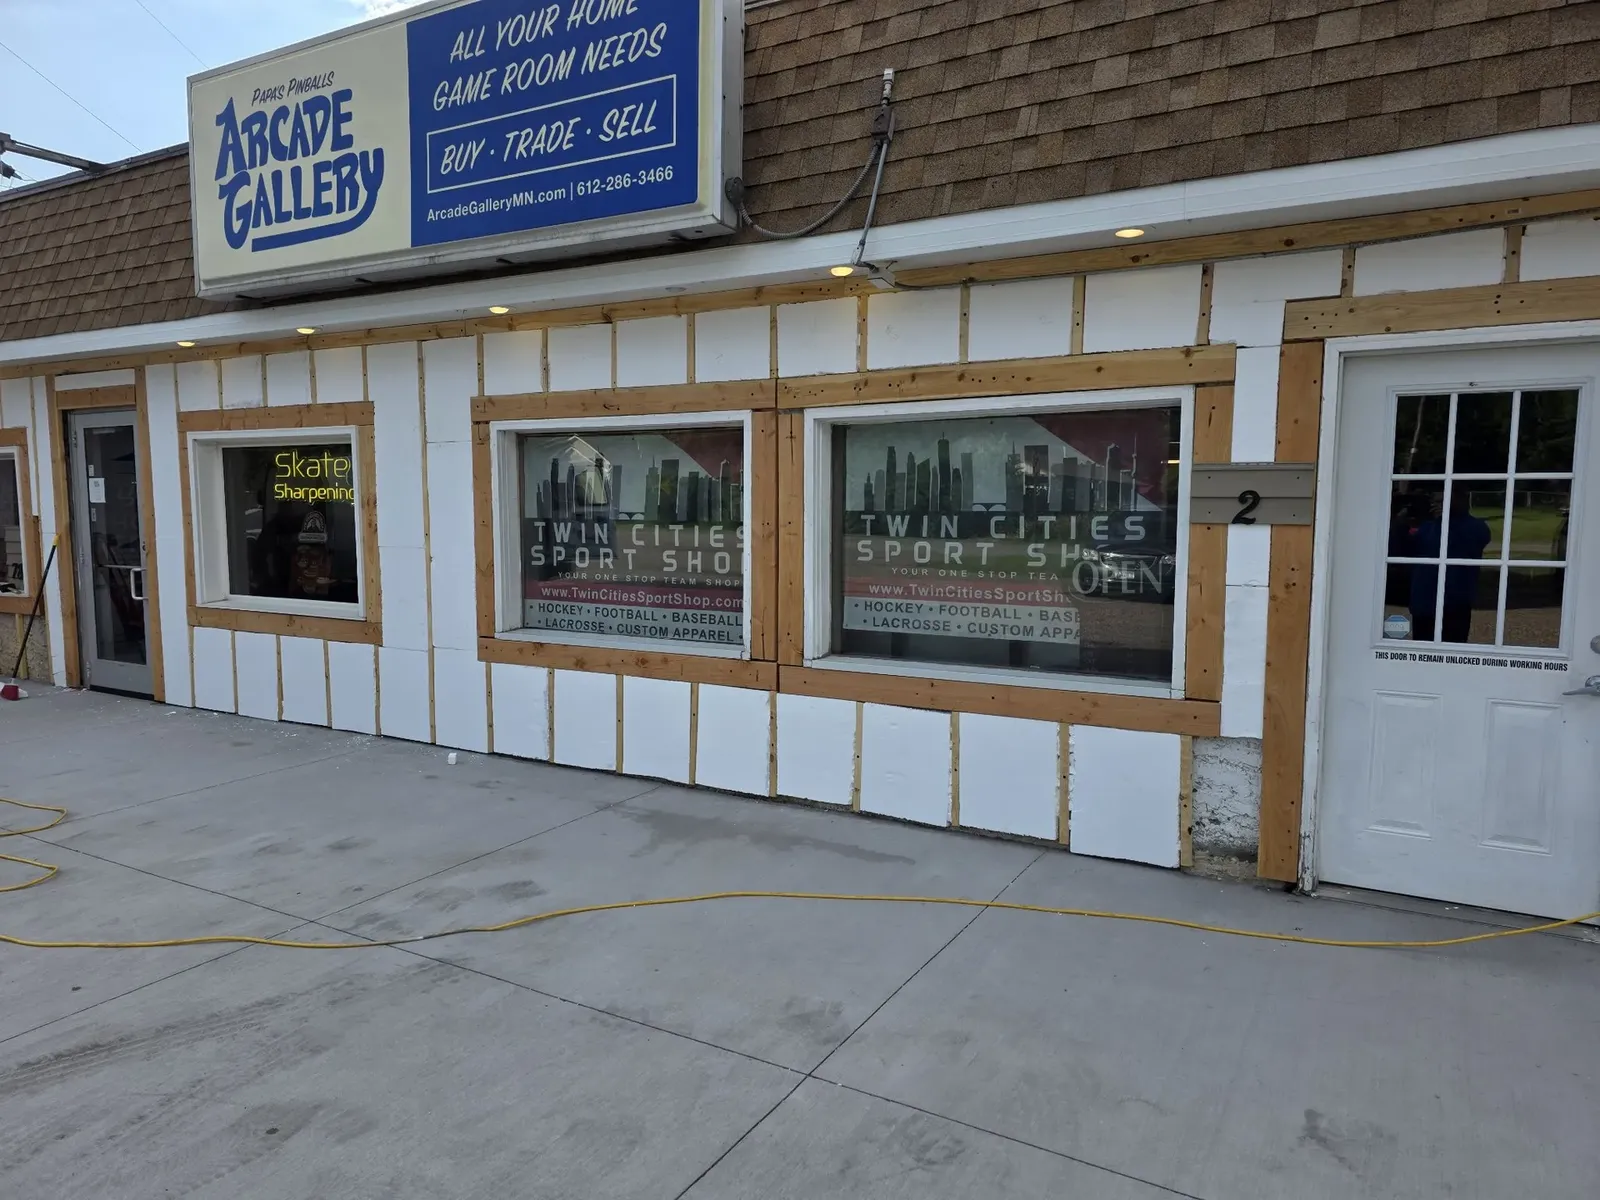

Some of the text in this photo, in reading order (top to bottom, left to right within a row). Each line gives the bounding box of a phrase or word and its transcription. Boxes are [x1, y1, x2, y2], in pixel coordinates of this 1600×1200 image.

[450, 25, 486, 64] ALL
[496, 4, 560, 52] YOUR
[433, 22, 668, 111] GAME ROOM NEEDS
[251, 71, 335, 107] PAPA'S PINBALLS
[214, 88, 354, 182] ARCADE
[440, 99, 657, 175] BUY TRADE SELL
[218, 147, 385, 252] GALLERY
[427, 165, 674, 222] ArcadeGalleryMN.com 612-286-3466
[275, 451, 348, 478] Skate
[1231, 490, 1260, 525] 2
[533, 521, 609, 544] TWIN
[861, 514, 1146, 541] TWIN CITIES
[530, 545, 744, 574] SPORT SHO
[857, 540, 995, 566] SPORT
[558, 571, 740, 587] YOUR ONE STOP TEAM SHOP
[891, 567, 929, 577] YOUR
[938, 568, 968, 578] ONE
[978, 569, 1017, 579] STOP
[1072, 559, 1163, 594] OPEN
[541, 586, 743, 609] www.TwinCitiesSportShop.com
[864, 600, 924, 614] HOCKEY
[939, 604, 1022, 620] FOOTBALL
[538, 602, 743, 627] HOCKEY FOOTBALL BASEBALL
[872, 616, 951, 632] LACROSSE
[967, 622, 1034, 637] CUSTOM
[545, 617, 735, 642] LACROSSE CUSTOM APPAREL
[1375, 651, 1568, 672] THIS DOOR TO REMAIN UNLOCKED DURING WORKING HOURS
